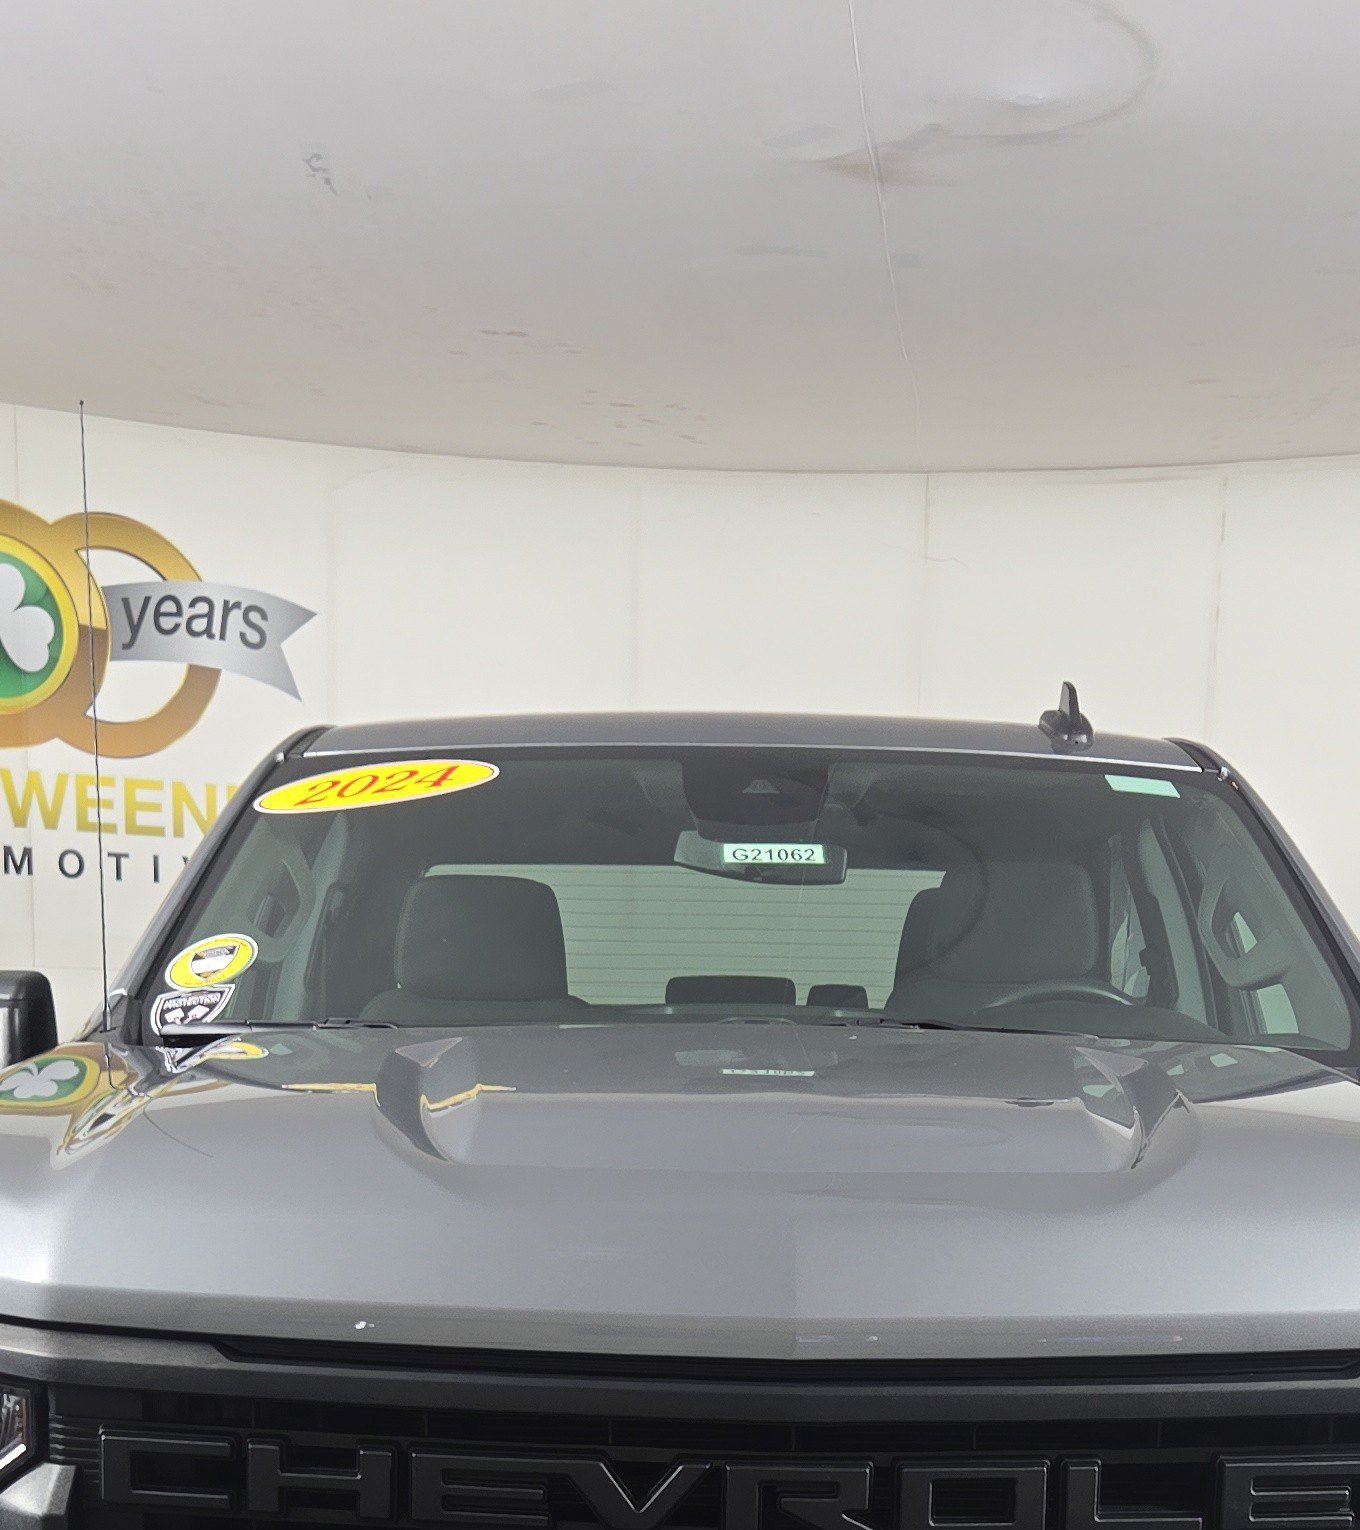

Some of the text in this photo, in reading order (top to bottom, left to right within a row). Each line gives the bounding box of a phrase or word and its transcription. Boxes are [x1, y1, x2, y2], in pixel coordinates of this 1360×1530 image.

[120, 592, 269, 651] years
[293, 765, 459, 806] 2024
[732, 848, 816, 862] G21062
